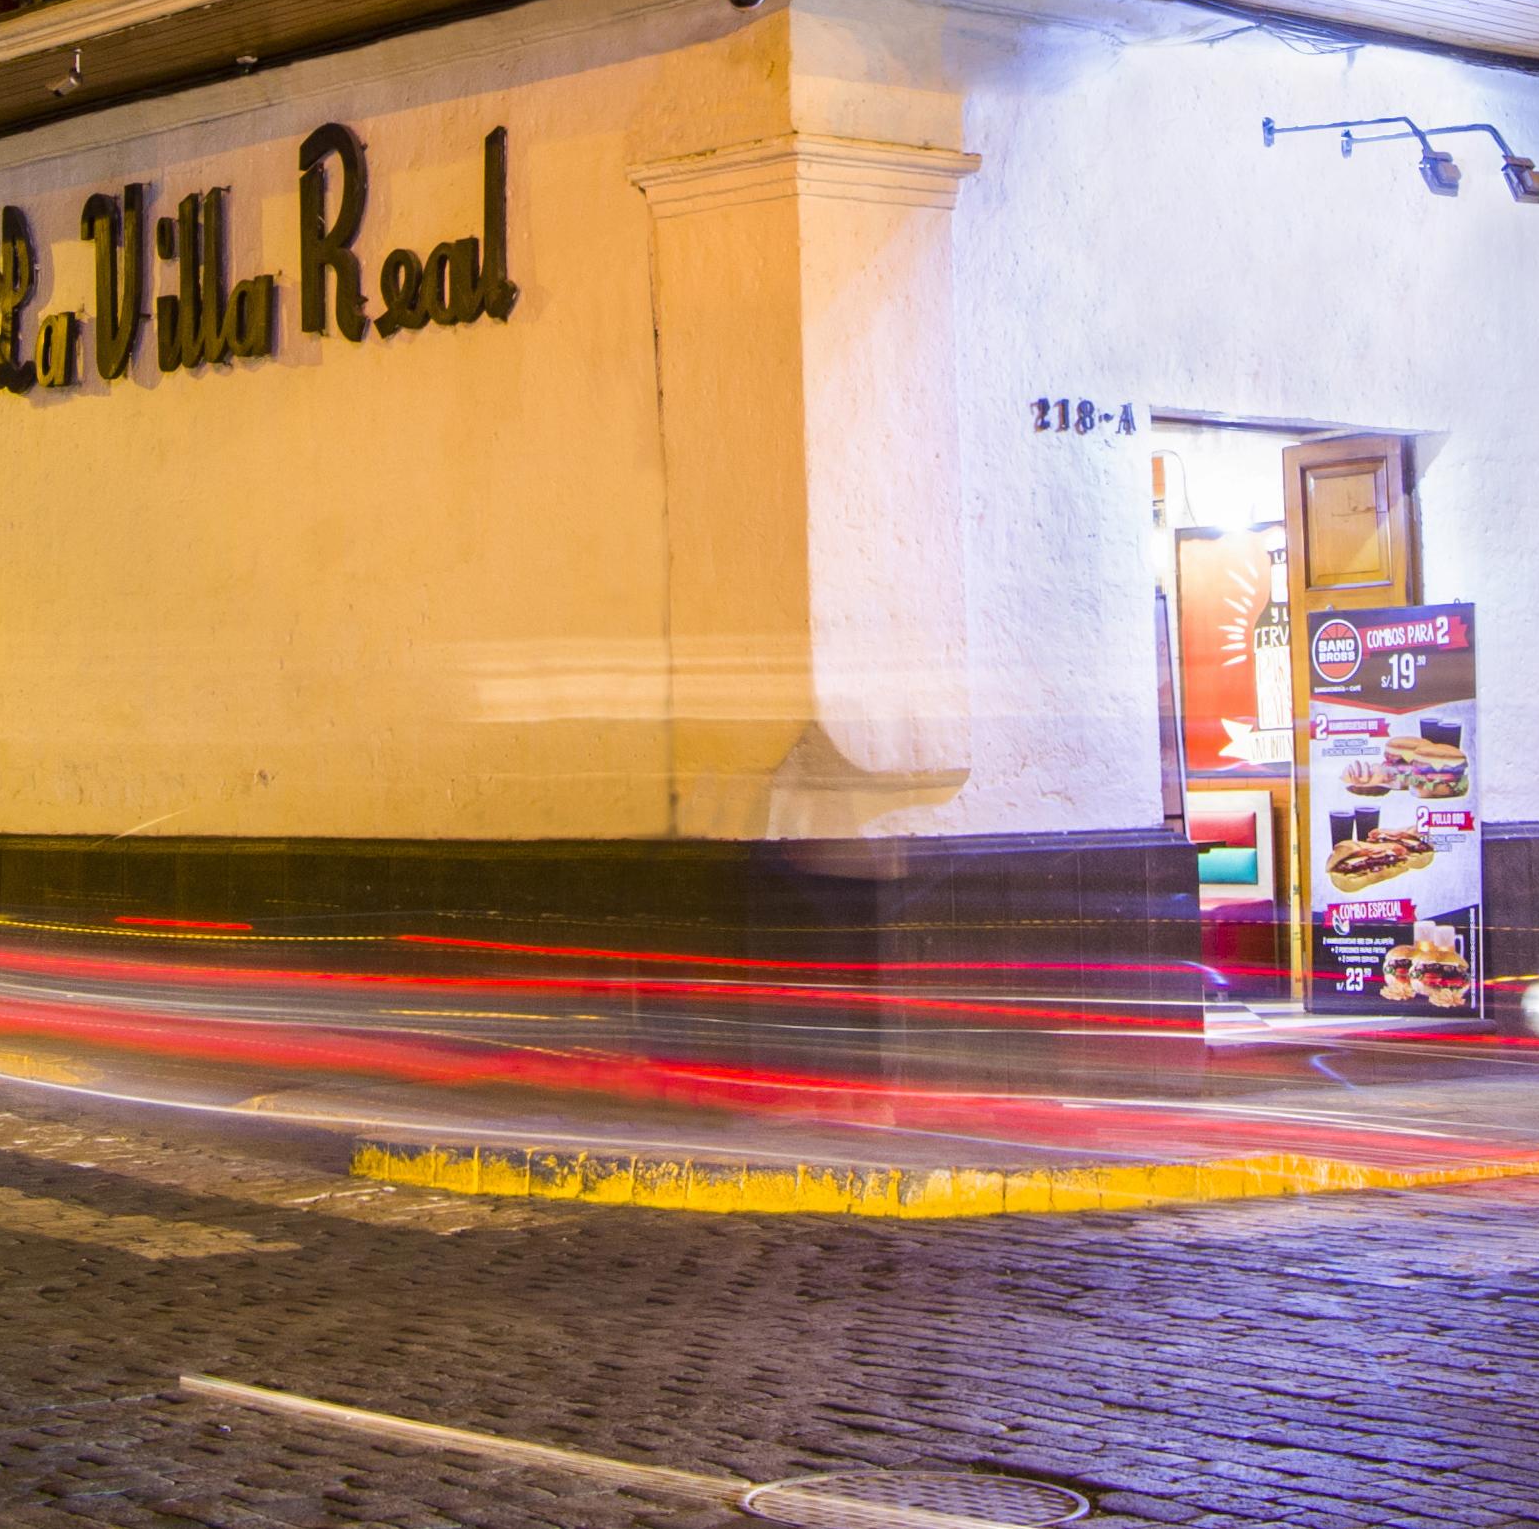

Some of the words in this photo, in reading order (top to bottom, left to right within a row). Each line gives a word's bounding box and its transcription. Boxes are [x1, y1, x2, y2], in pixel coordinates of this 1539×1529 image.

[81, 182, 274, 379] Villa
[299, 122, 518, 342] Real
[1030, 398, 1137, 435] 218-A
[1318, 638, 1355, 652] SAND
[1367, 628, 1406, 648] COMBOS
[1407, 623, 1434, 644] PARA
[1435, 616, 1450, 645] 2
[1316, 713, 1328, 740] 2
[1417, 805, 1429, 833] 2
[1340, 903, 1367, 920] COMBO
[1368, 901, 1403, 918] ESPECIAL
